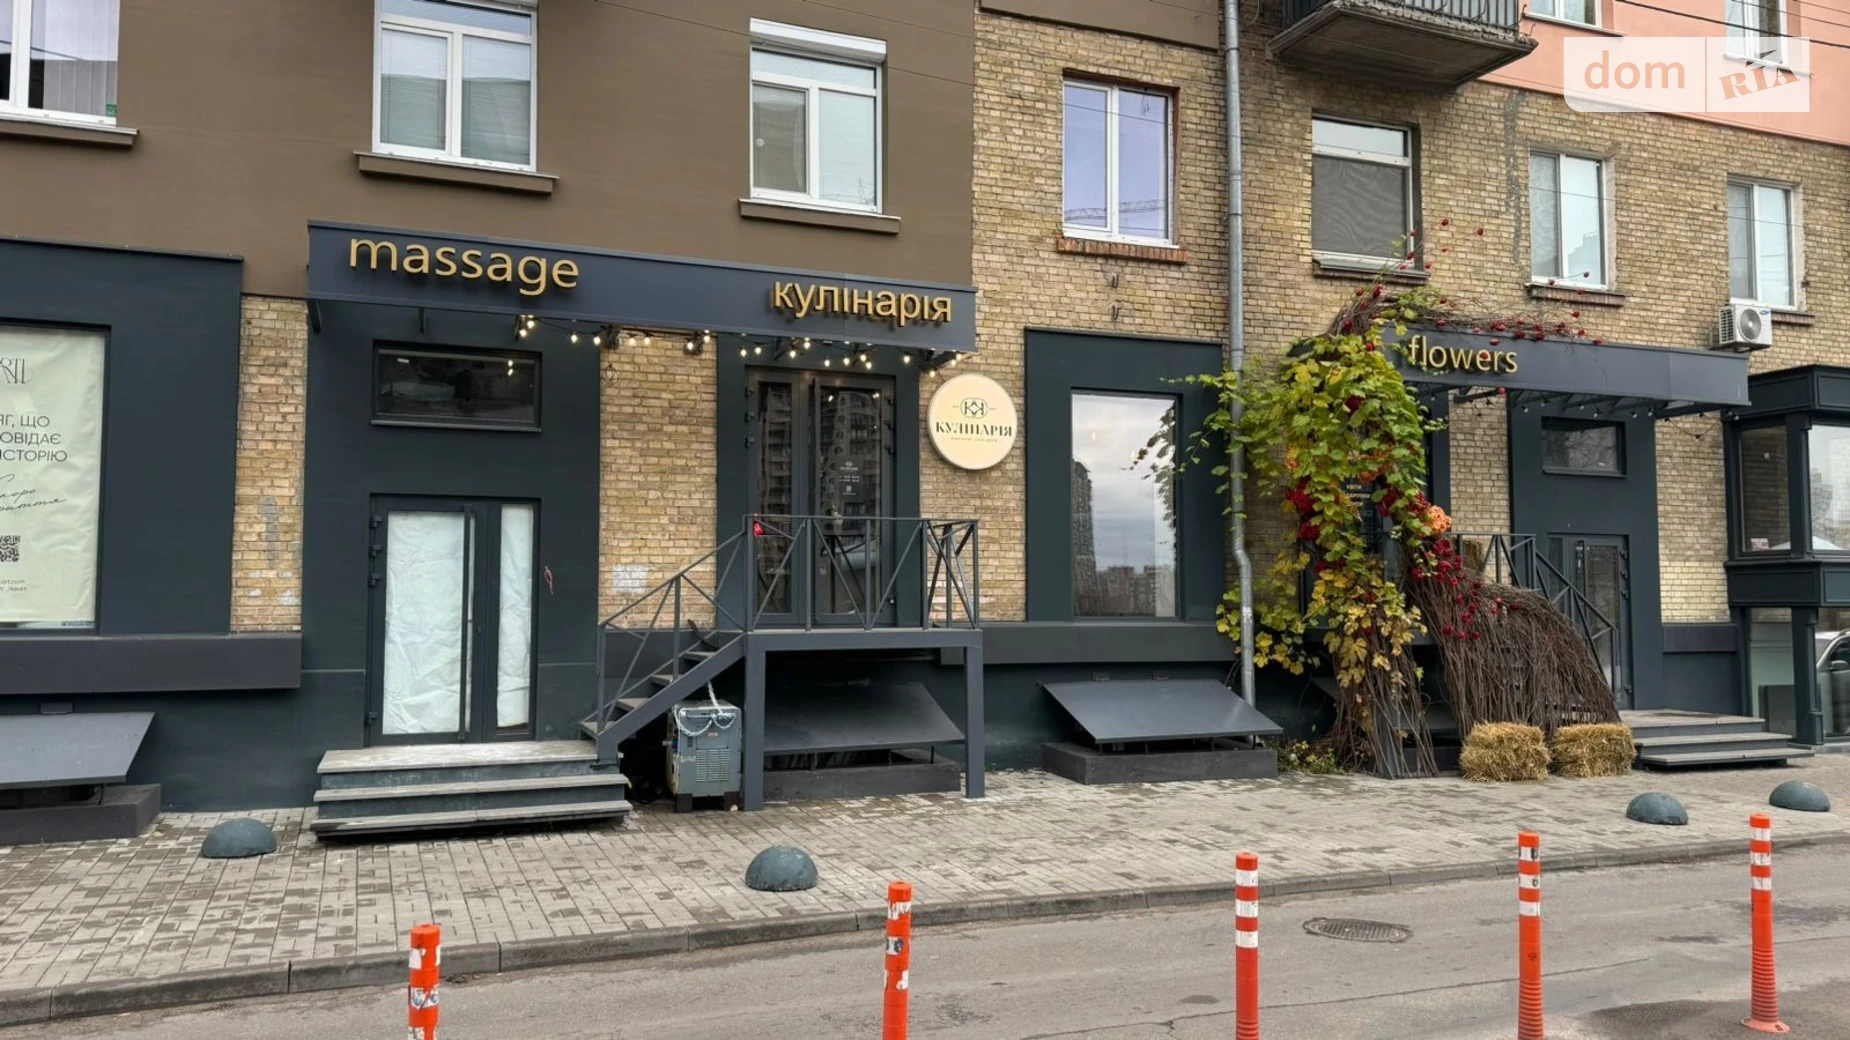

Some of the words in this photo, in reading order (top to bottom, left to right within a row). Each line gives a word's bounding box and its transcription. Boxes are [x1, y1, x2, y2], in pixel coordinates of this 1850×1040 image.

[349, 238, 580, 297] massage
[773, 281, 952, 327] кулінарія
[1408, 334, 1518, 374] flowers
[20, 415, 51, 429] ЩО
